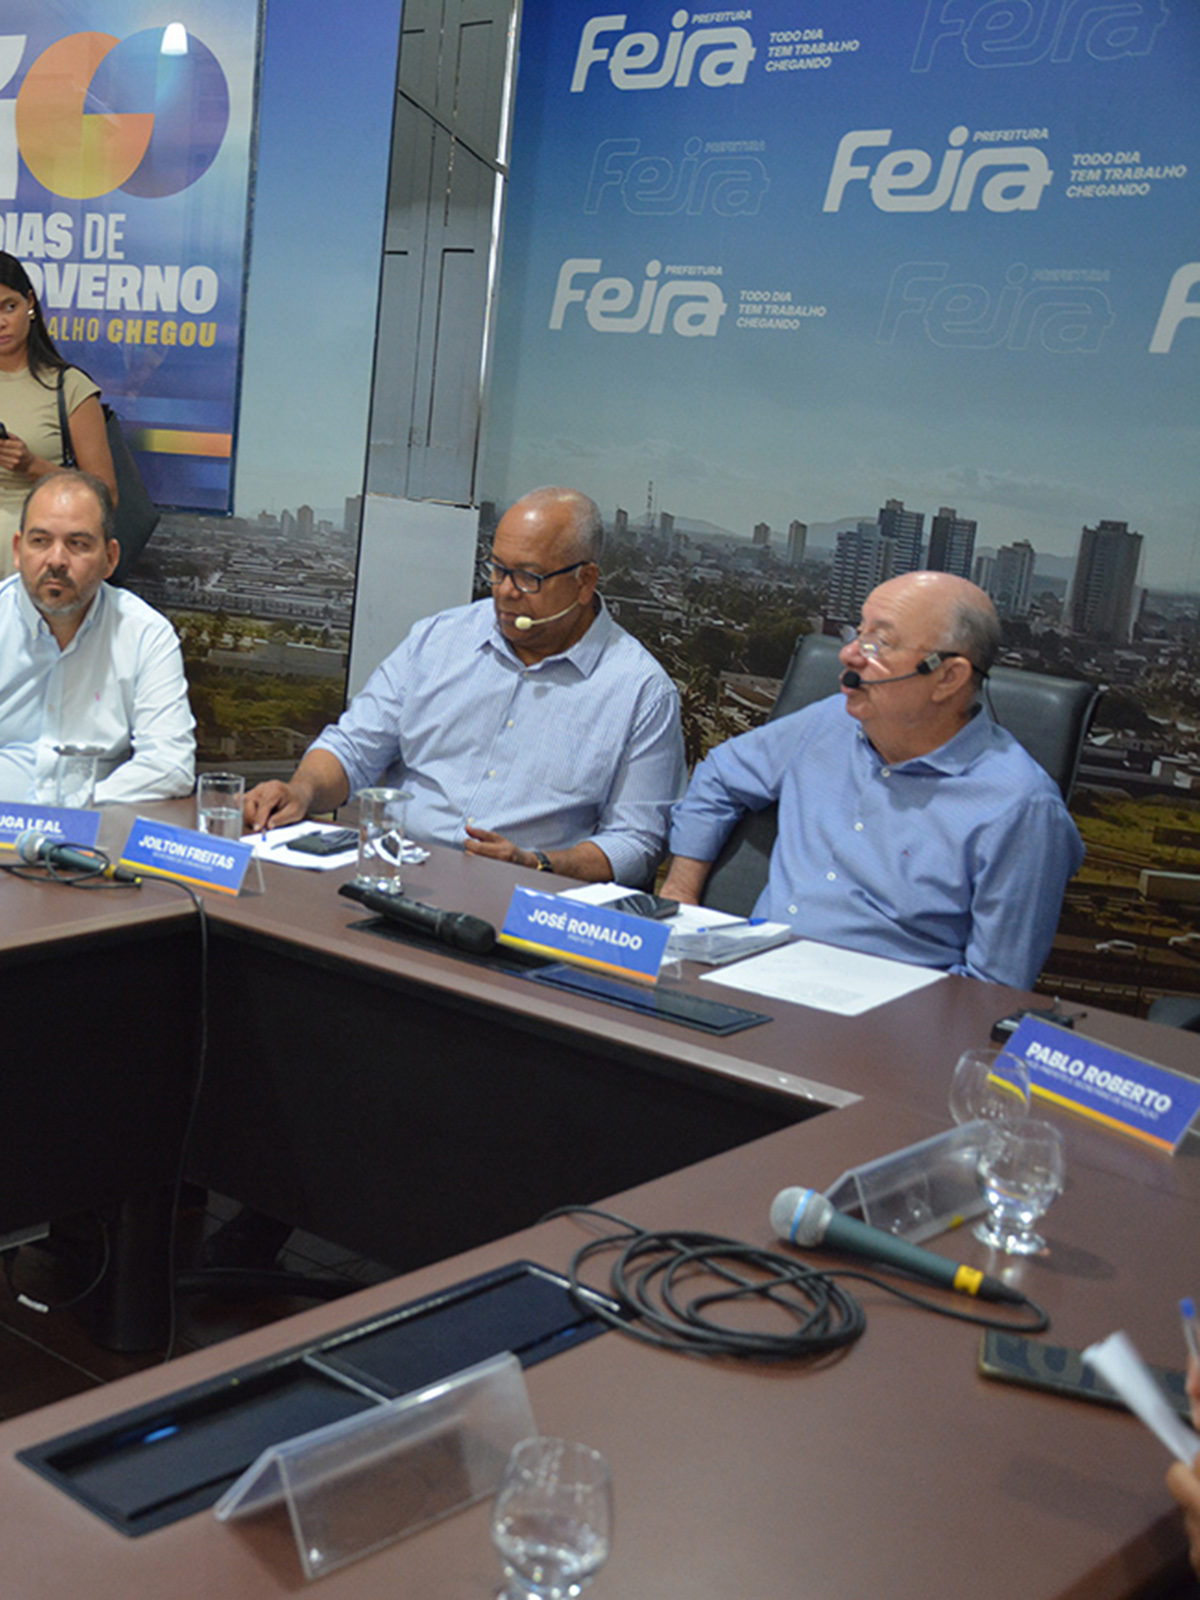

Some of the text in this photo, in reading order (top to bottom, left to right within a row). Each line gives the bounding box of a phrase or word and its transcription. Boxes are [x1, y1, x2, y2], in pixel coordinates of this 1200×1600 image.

[691, 10, 752, 24] PREFEITURA
[769, 29, 824, 43] TODO DIA
[570, 9, 757, 93] Feira
[768, 40, 860, 58] TEM TRABALHO
[765, 57, 832, 72] CHEGANDO
[972, 128, 1049, 142] PREFEITURA
[1072, 151, 1141, 166] TODO DIA
[822, 125, 1054, 213] Feira
[1069, 164, 1188, 182] TEM TRABALHO
[1066, 182, 1150, 198] CHEGANDO
[83, 213, 126, 260] DE
[664, 265, 723, 276] PREFEITURA
[20, 261, 219, 314] VERNO
[739, 290, 792, 302] TODO DIA
[548, 258, 728, 337] Feira
[738, 303, 827, 318] TEM TRABALHO
[46, 316, 218, 348] ALHO CHEGOU
[736, 317, 801, 330] CHEGANDO
[26, 818, 62, 834] LEAL
[138, 834, 188, 857] JOILTON
[186, 846, 235, 870] FREITAS
[527, 908, 568, 932] JOSÉ
[566, 919, 644, 950] RONALDO
[1025, 1041, 1085, 1078] PABLO
[1082, 1065, 1173, 1114] ROBERTO
